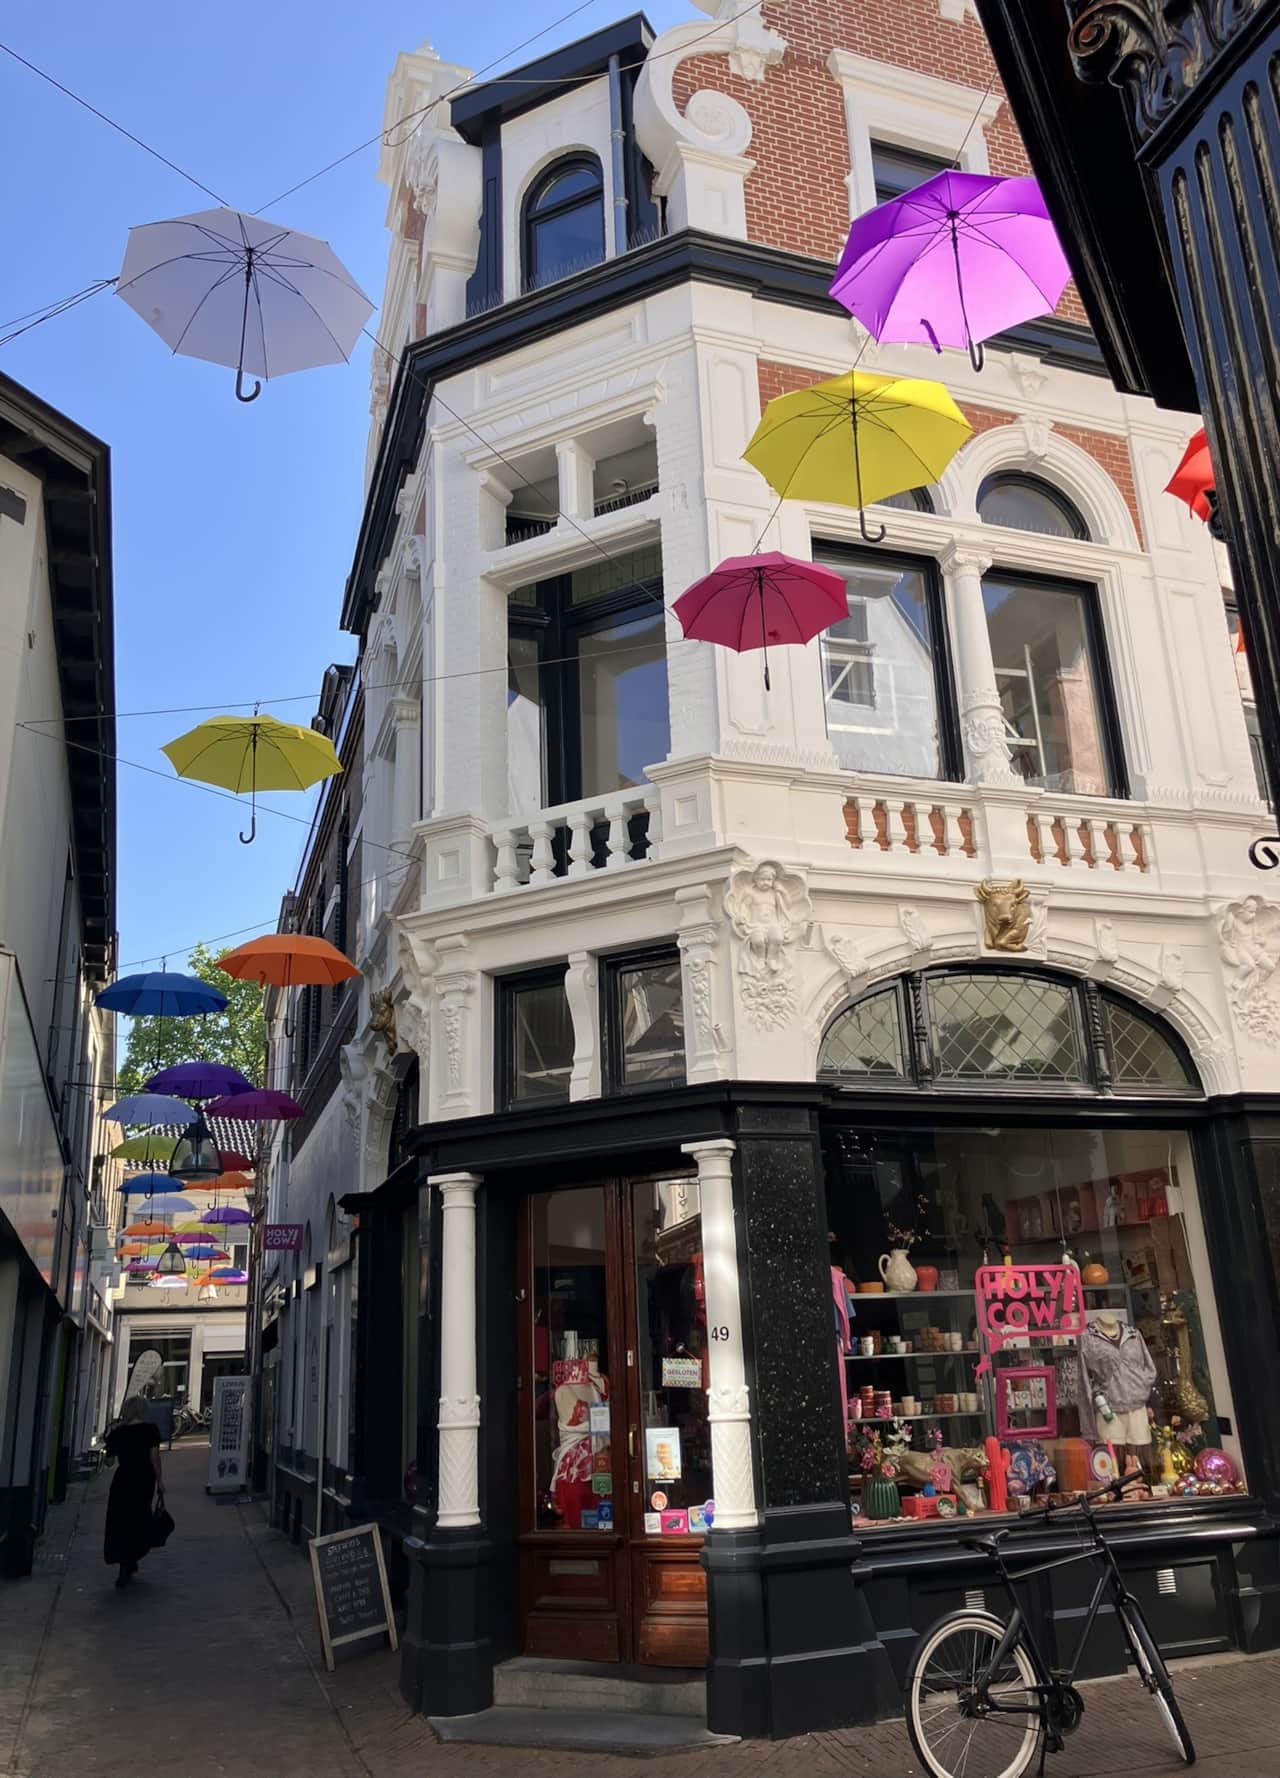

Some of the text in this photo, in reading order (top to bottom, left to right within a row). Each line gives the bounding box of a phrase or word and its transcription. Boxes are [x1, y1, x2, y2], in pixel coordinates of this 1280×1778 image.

[267, 1229, 294, 1238] HOLY
[983, 1272, 1062, 1299] HOLY
[711, 1326, 729, 1342] 49
[666, 1368, 698, 1377] GESLOTEN
